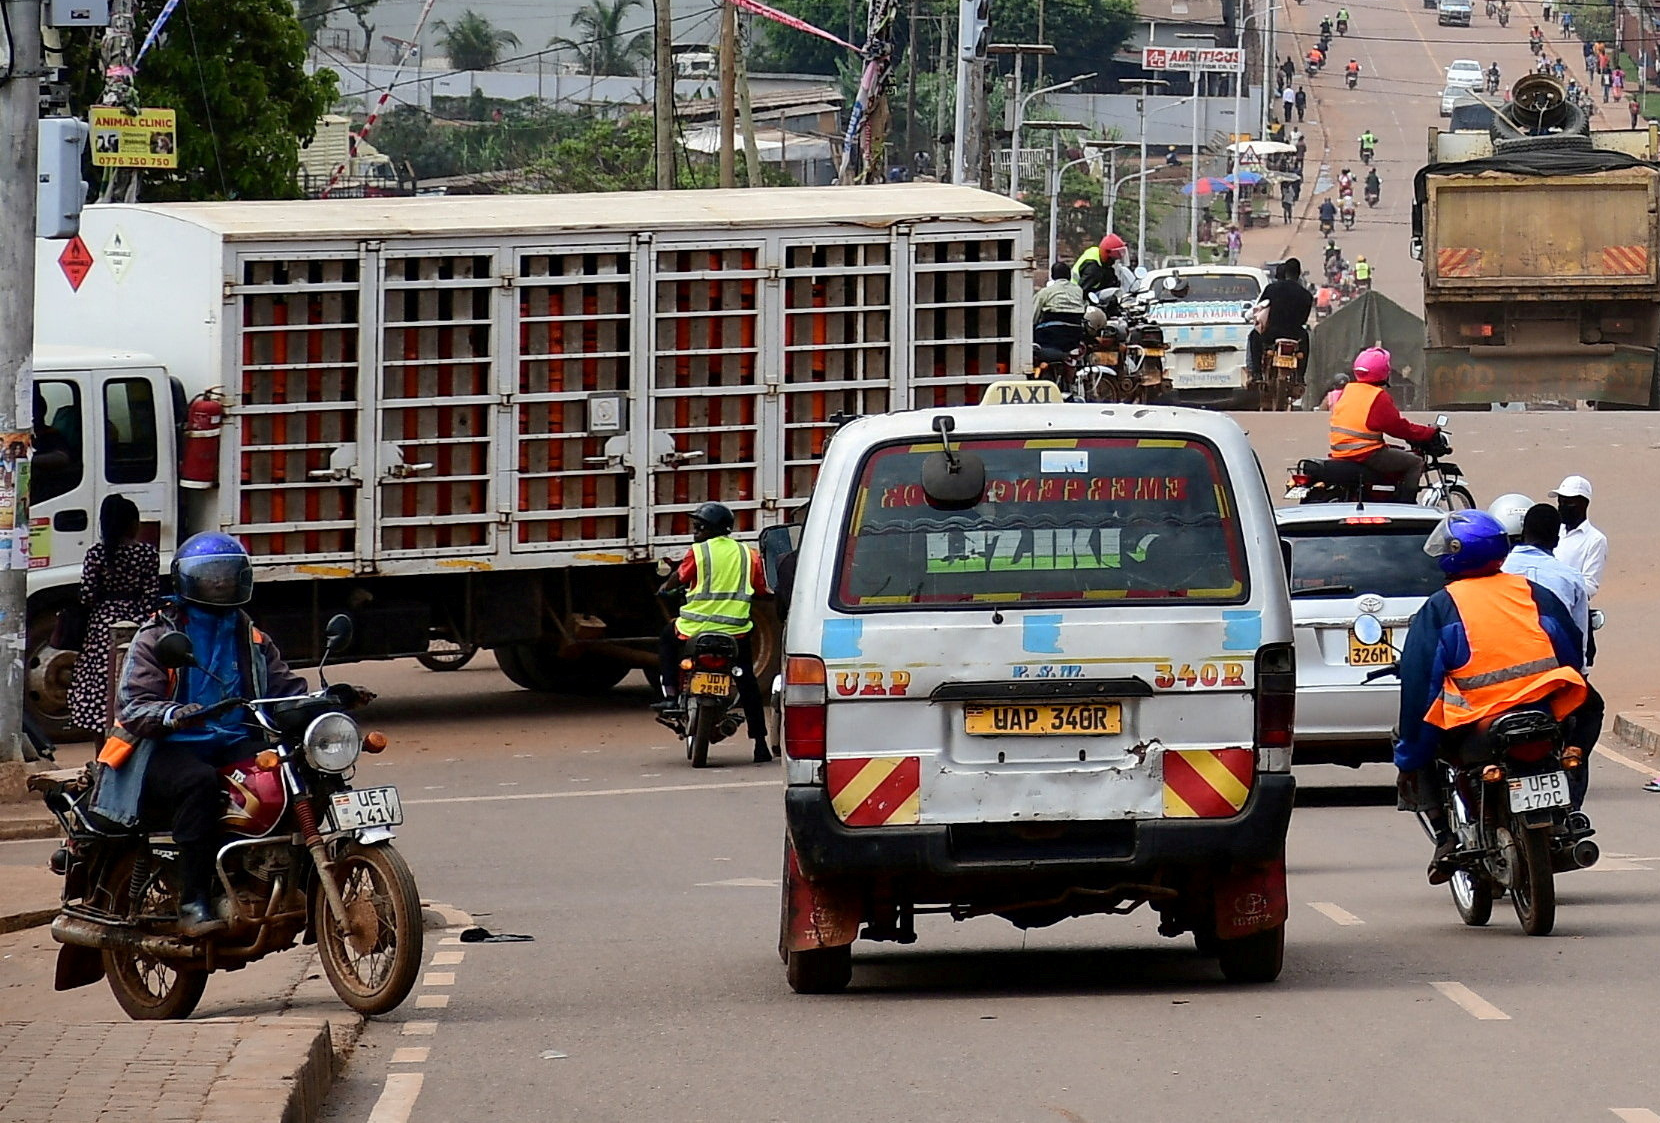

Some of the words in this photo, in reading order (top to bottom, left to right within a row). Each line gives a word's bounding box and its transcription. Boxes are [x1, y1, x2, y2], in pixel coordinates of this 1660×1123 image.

[95, 117, 136, 127] ANIMAL
[138, 118, 173, 128] CLINIC
[99, 157, 124, 166] 0776
[151, 158, 170, 166] 750
[996, 385, 1052, 405] TAXI
[1352, 647, 1389, 664] 326M
[1154, 664, 1246, 688] 340R
[993, 707, 1039, 732] UAP
[1049, 707, 1108, 731] 340R
[1529, 774, 1560, 792] UFB
[357, 789, 389, 807] UET
[1523, 791, 1564, 810] 179C
[355, 806, 396, 826] 141V
